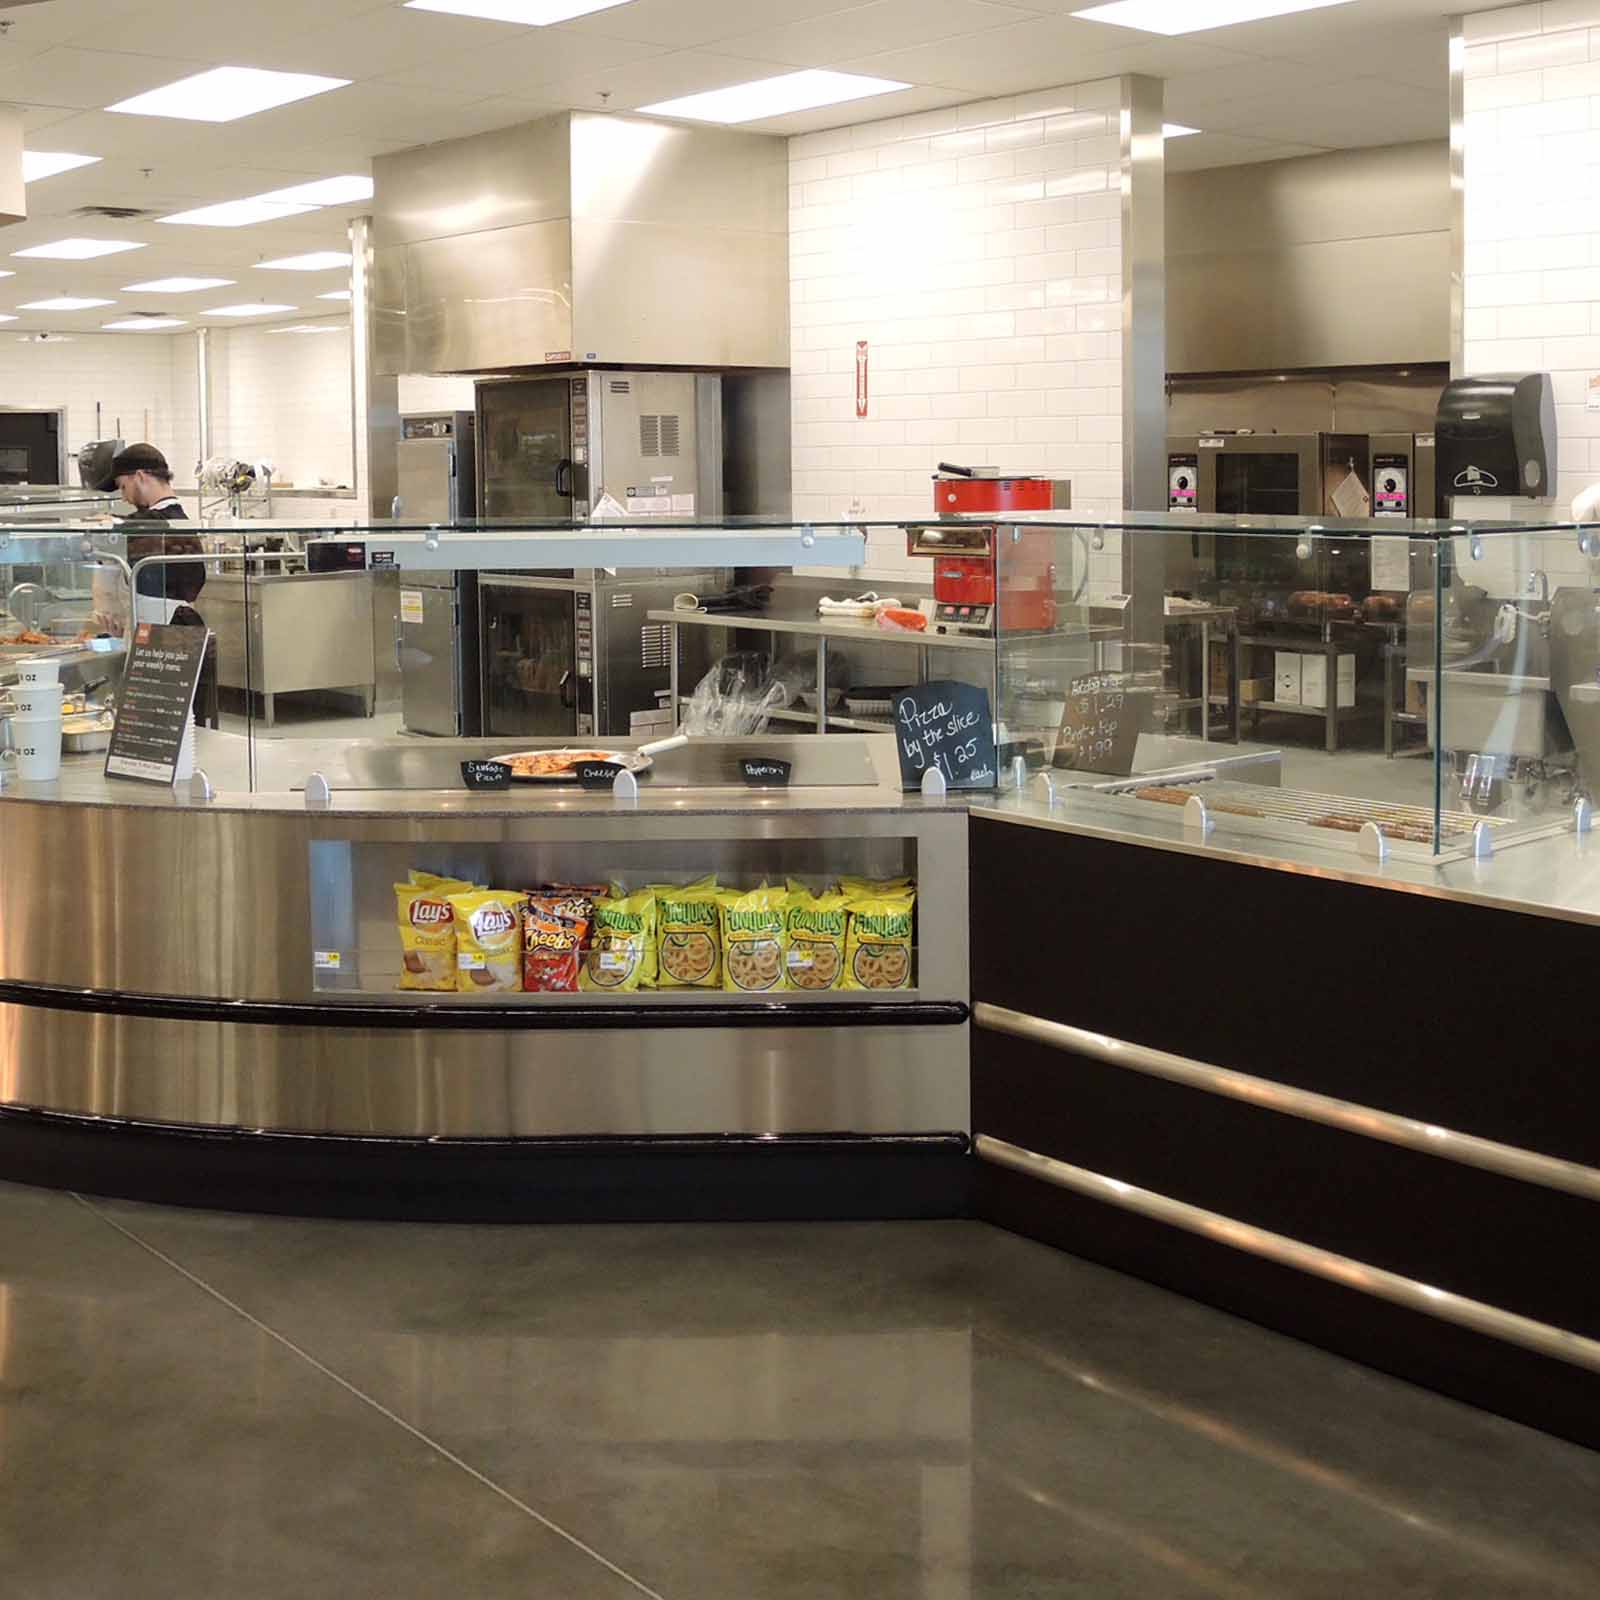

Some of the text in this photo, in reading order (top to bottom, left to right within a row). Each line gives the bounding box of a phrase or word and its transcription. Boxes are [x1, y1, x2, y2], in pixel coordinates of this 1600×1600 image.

[899, 697, 953, 732] Pizza
[903, 711, 980, 769] by the slice
[970, 763, 994, 781] each
[524, 928, 576, 952] Cheetos
